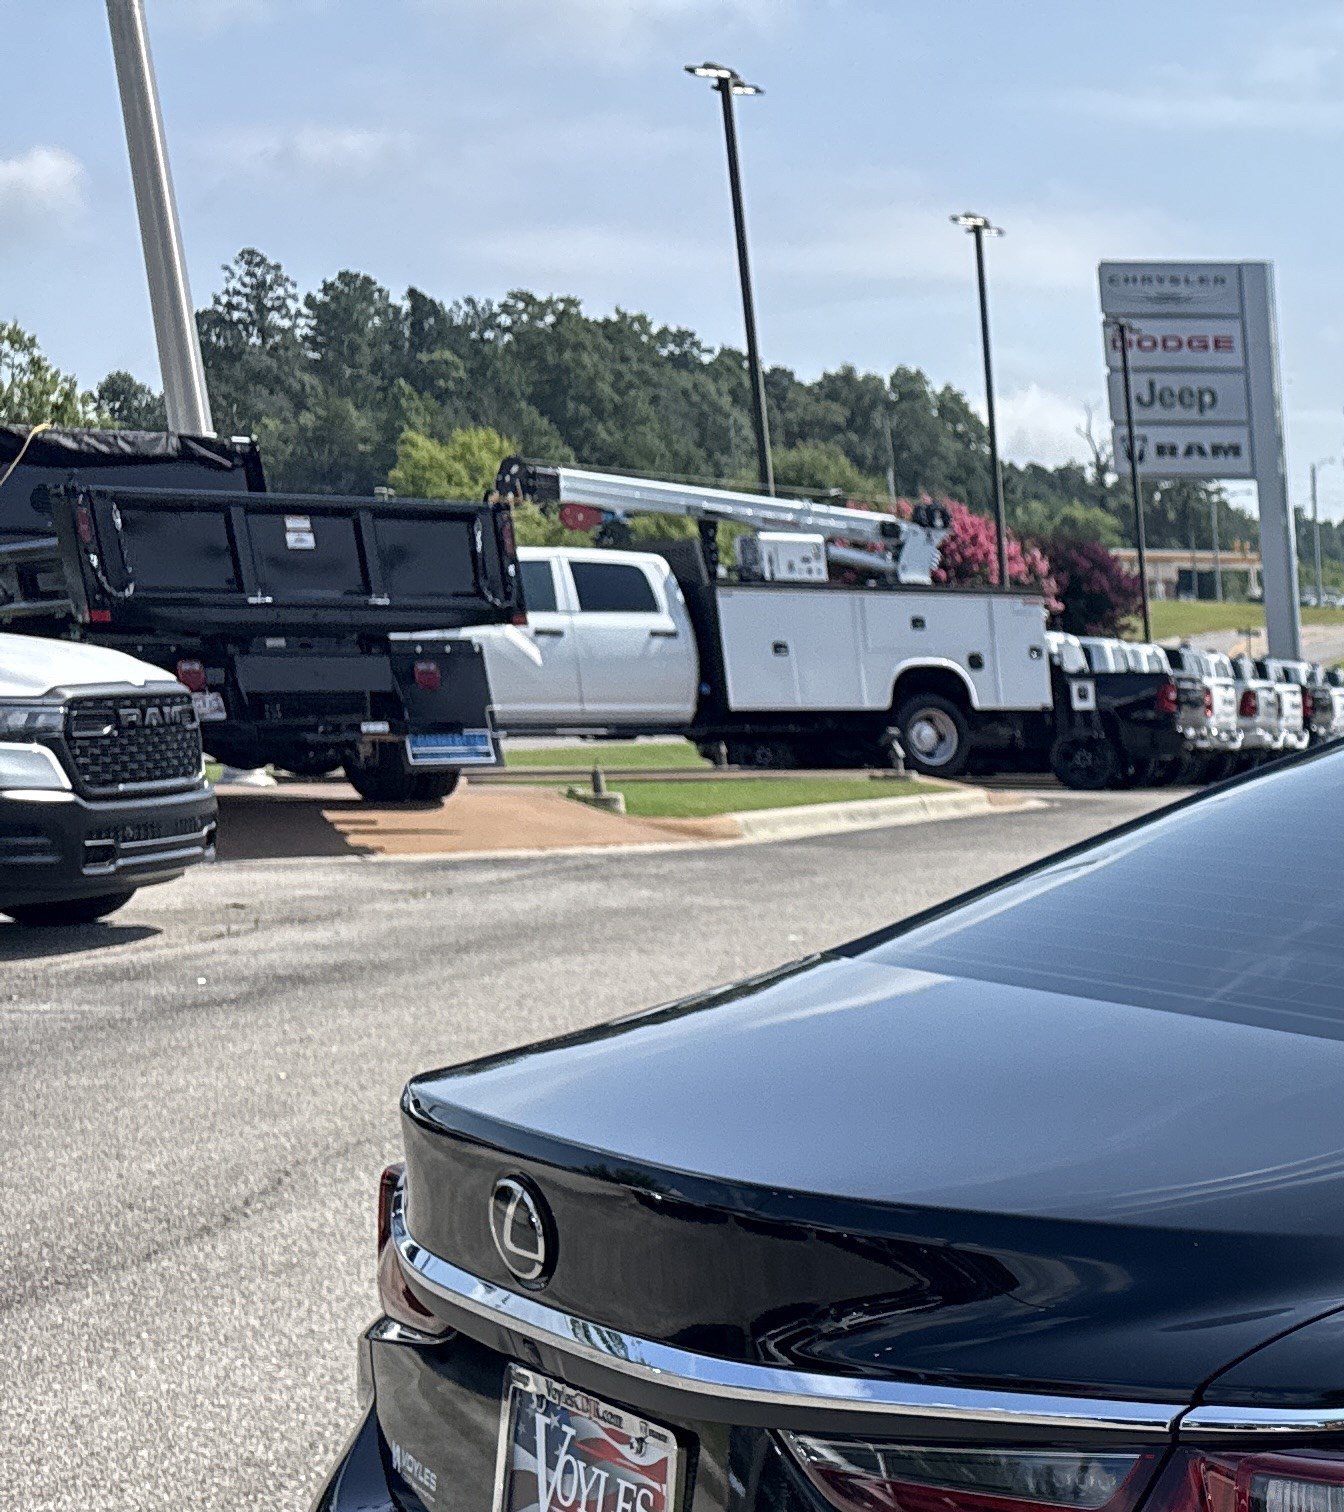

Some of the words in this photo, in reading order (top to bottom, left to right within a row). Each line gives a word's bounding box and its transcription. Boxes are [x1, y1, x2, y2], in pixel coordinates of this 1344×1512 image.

[1111, 335, 1235, 353] DODGE
[1135, 379, 1218, 416] Jeep
[1155, 442, 1241, 458] RAM
